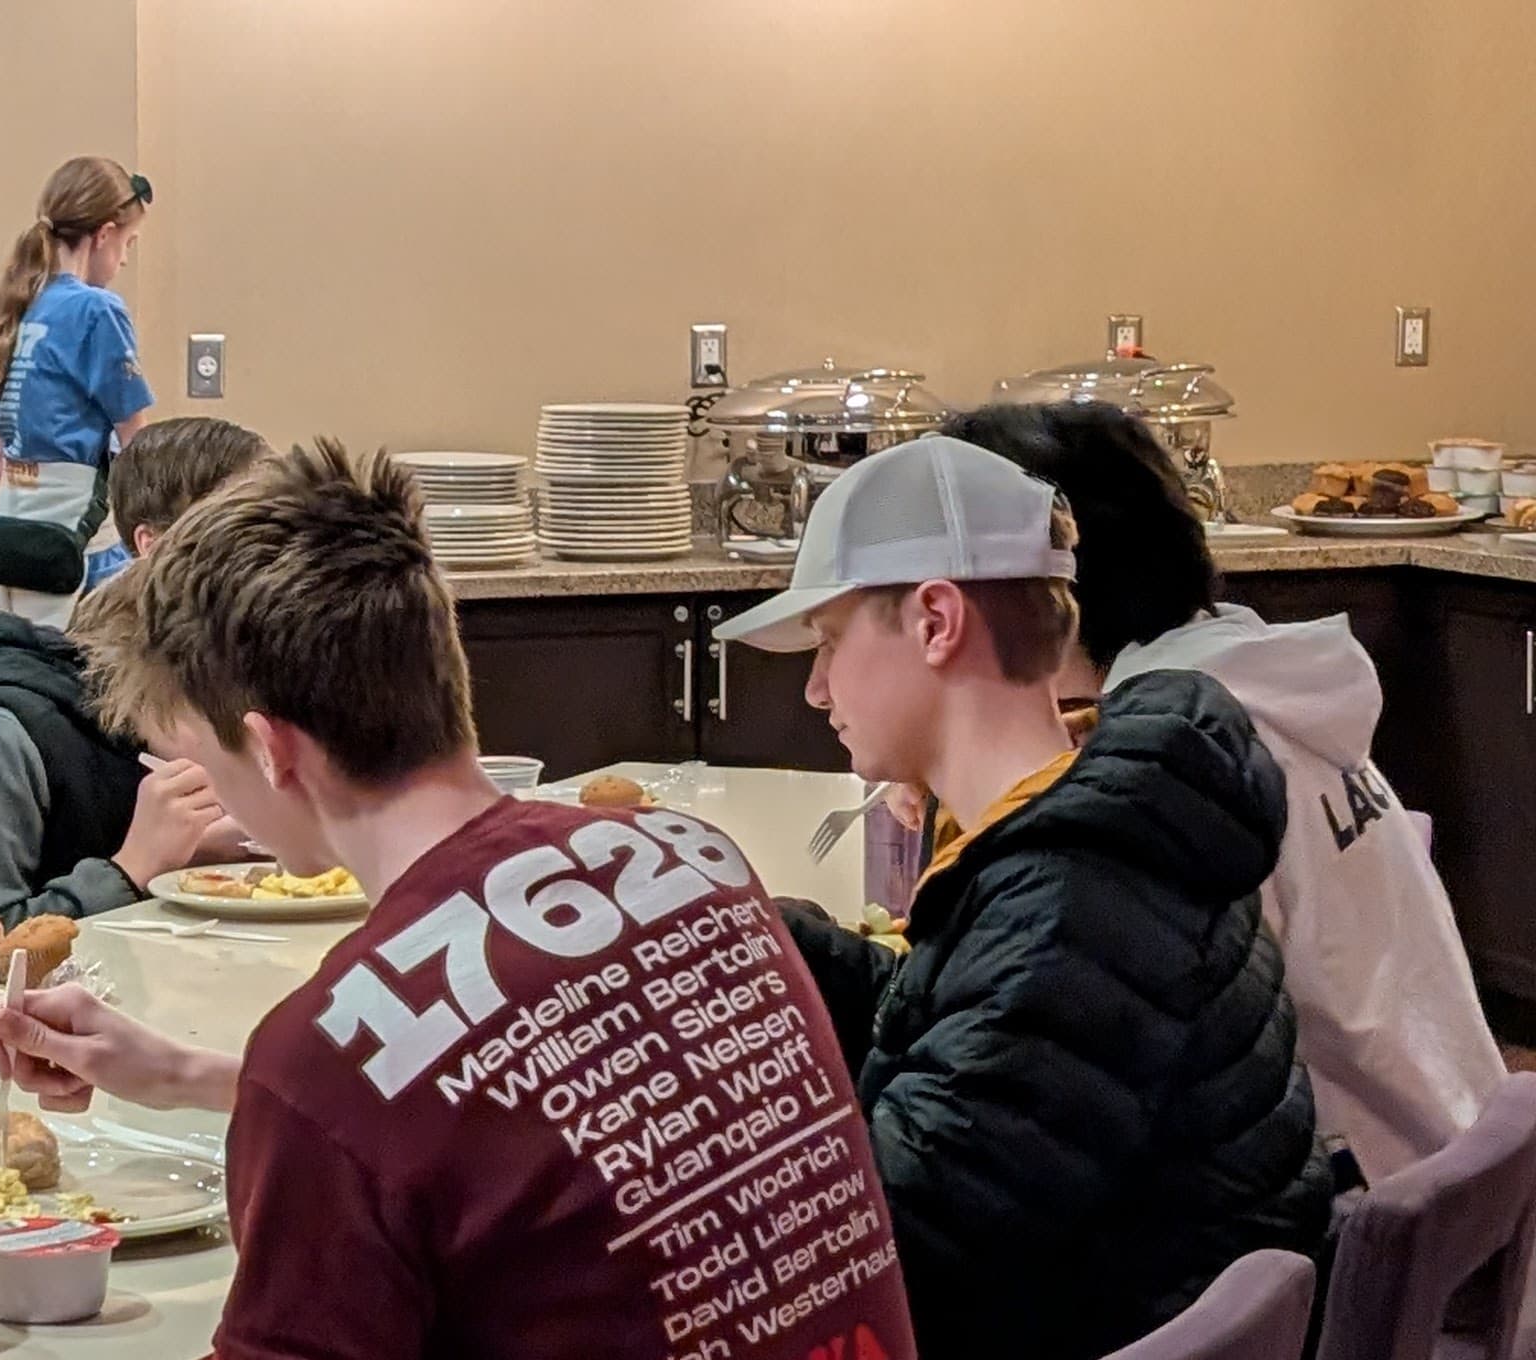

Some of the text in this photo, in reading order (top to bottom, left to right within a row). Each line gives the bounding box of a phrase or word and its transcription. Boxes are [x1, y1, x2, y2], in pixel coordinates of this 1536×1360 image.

[317, 810, 750, 1100] 17628
[436, 897, 770, 1105] Madeline Reichert
[488, 928, 783, 1110] William Bertolini
[542, 971, 786, 1120] Owen Siders
[561, 1005, 806, 1156] Kane Nelsen
[594, 1033, 814, 1181] Rylan Wolff
[803, 1068, 835, 1106] Li
[650, 1135, 850, 1257] Tim Wodrich
[650, 1169, 864, 1301] Todd Liebnow
[664, 1201, 880, 1342] David Bertolini
[738, 1238, 897, 1343] Westerhaus
